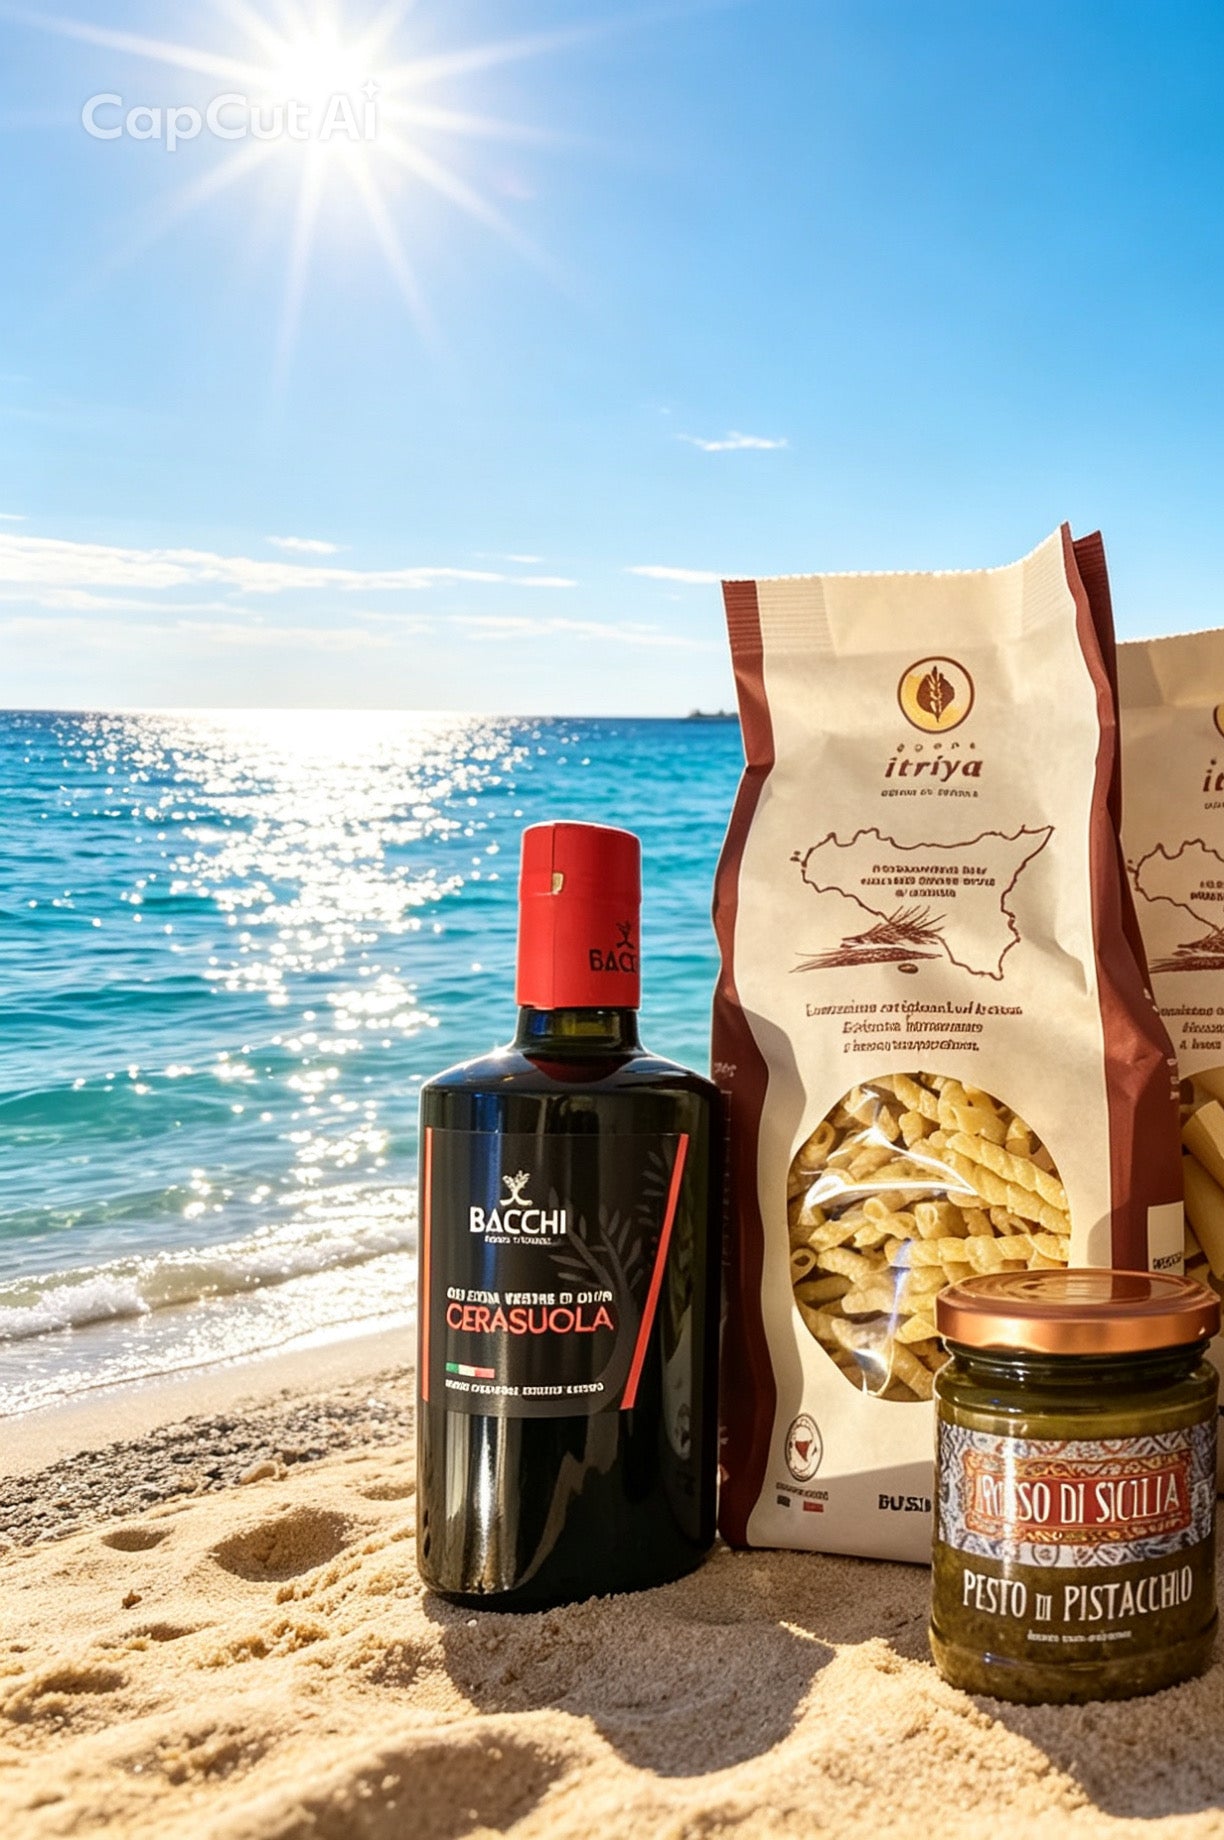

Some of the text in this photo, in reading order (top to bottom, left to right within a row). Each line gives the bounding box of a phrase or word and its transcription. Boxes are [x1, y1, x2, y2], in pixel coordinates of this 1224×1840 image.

[884, 755, 983, 782] itriya
[469, 1206, 567, 1235] BACCHI
[446, 1303, 614, 1335] CERASUOLA
[1060, 1483, 1085, 1524] DI
[1095, 1473, 1180, 1524] SICILIA
[963, 1568, 1027, 1619] PESTO
[1063, 1565, 1193, 1622] PISTACCHIO
